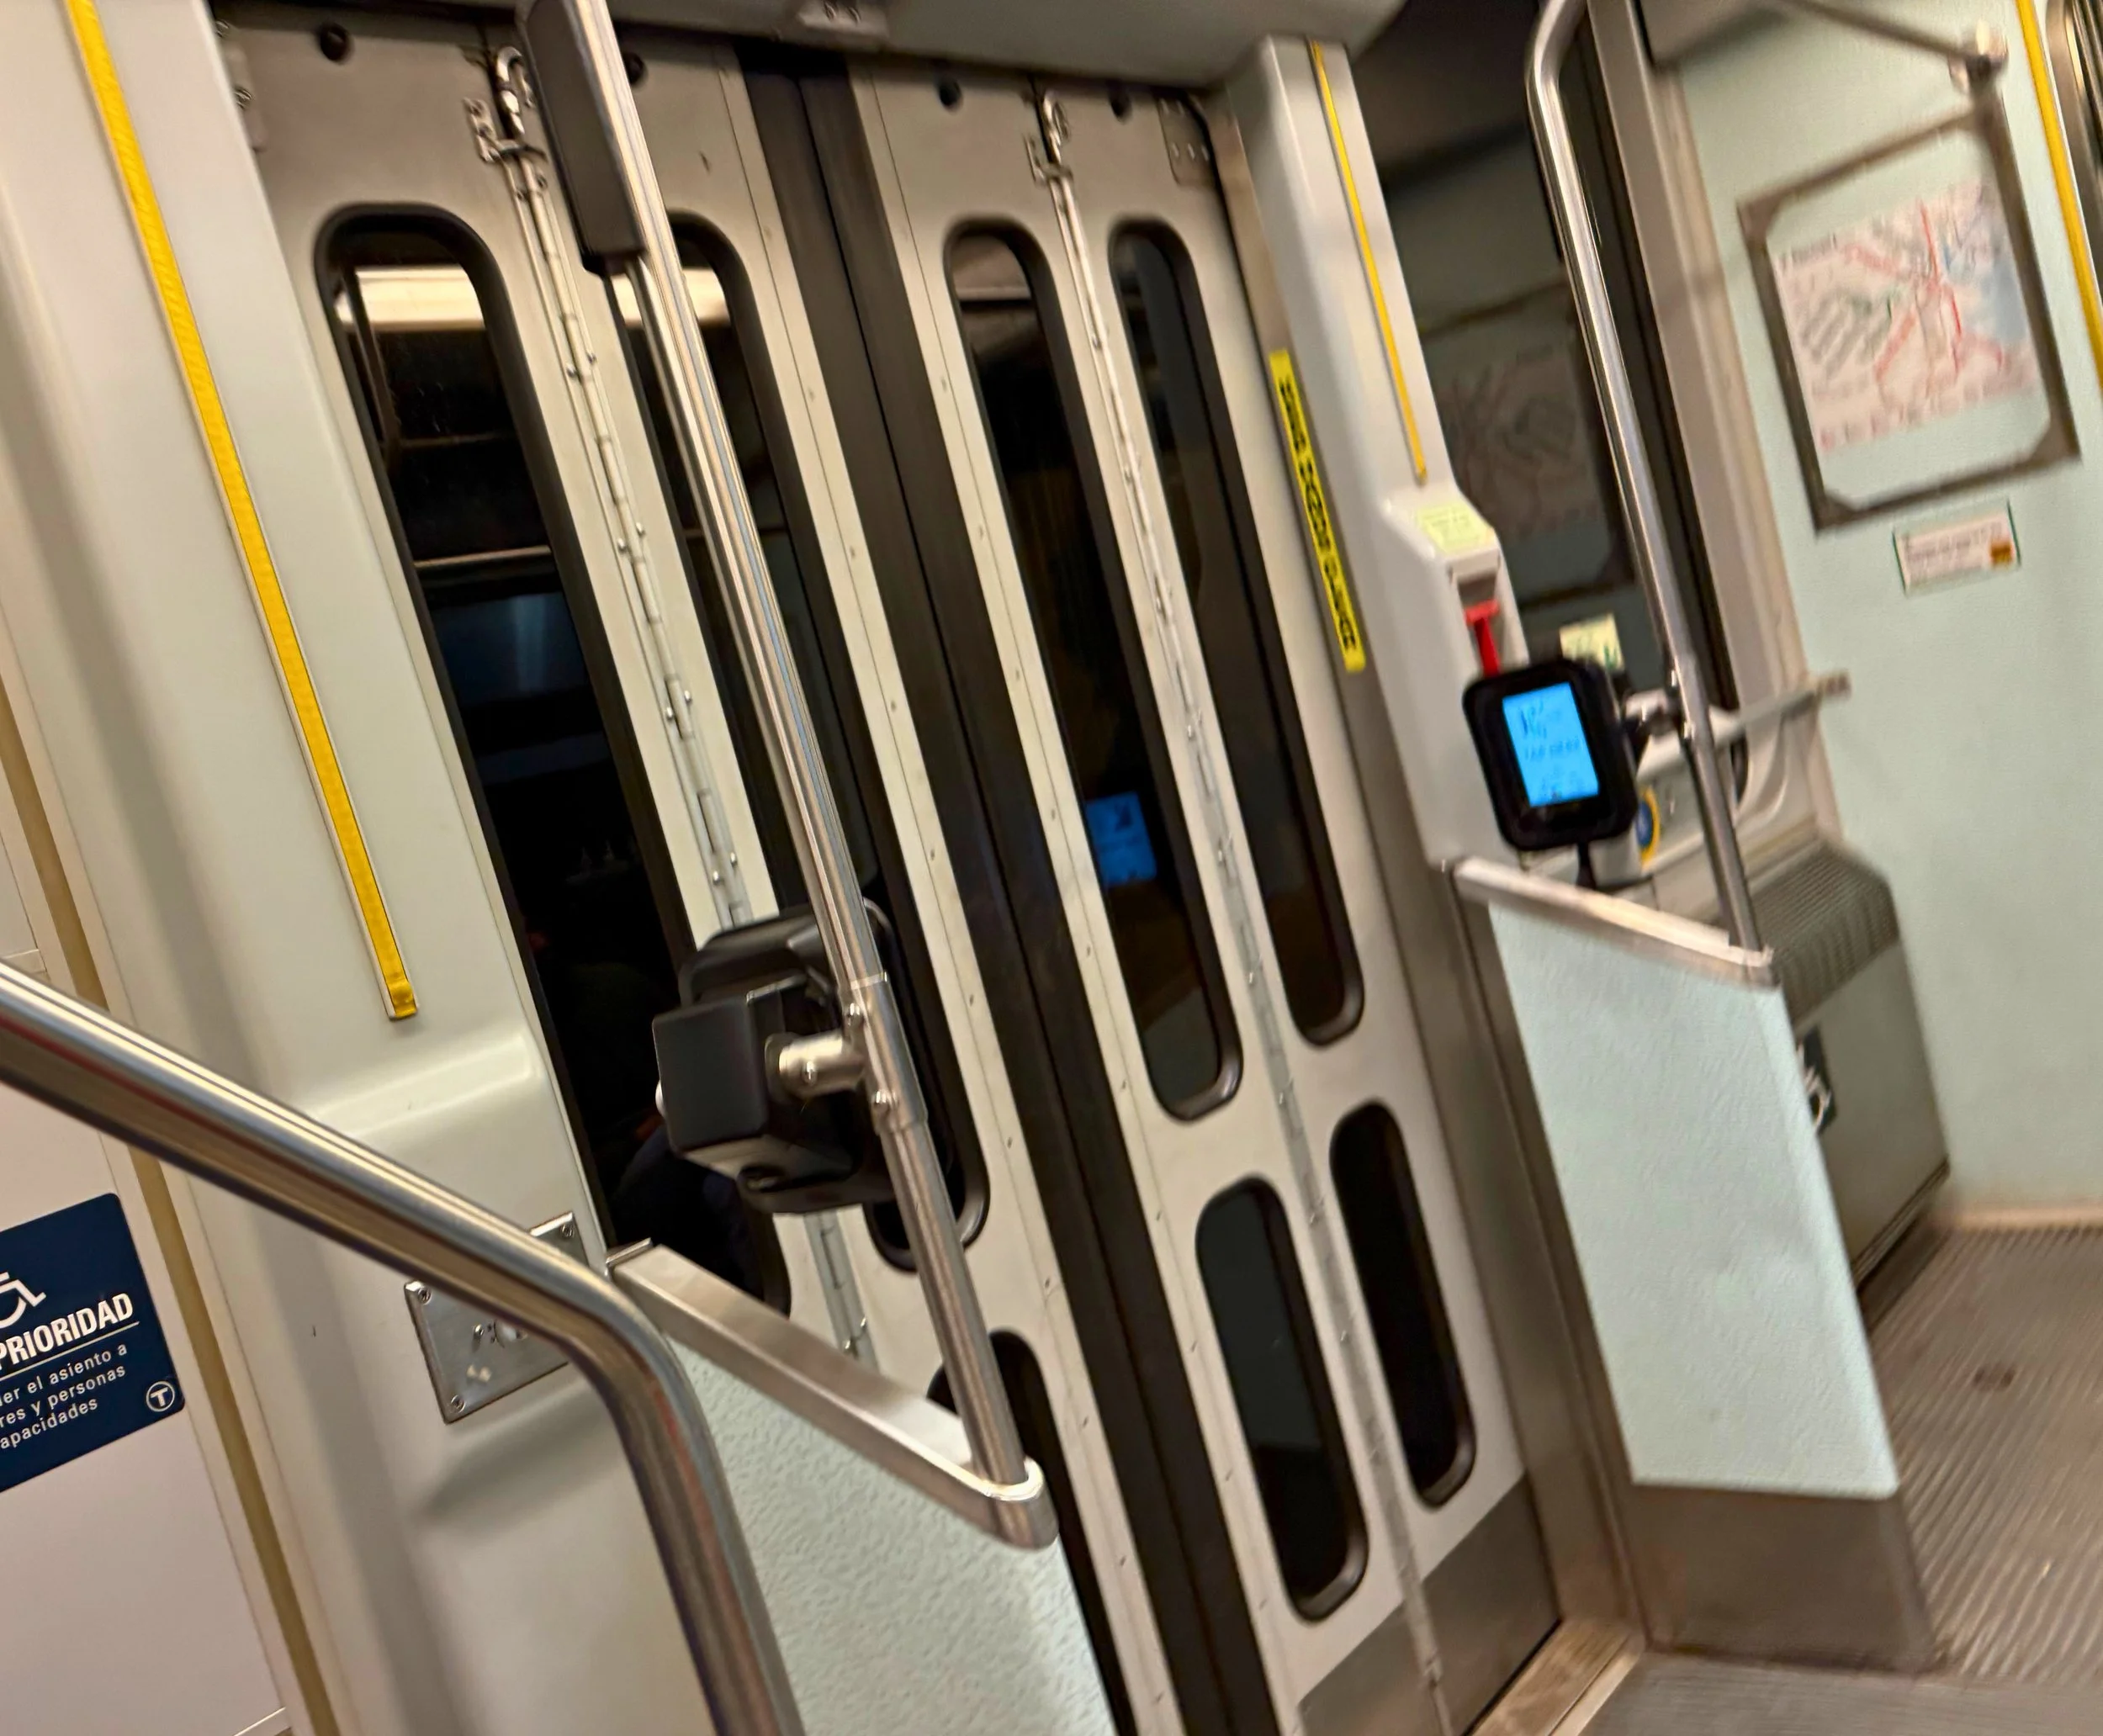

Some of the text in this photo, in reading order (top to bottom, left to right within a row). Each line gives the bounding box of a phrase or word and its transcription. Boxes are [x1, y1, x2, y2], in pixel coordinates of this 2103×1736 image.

[0, 1343, 128, 1407] er el asiento a
[31, 1400, 40, 1416] y
[47, 1365, 126, 1410] personas
[0, 1397, 98, 1448] apacidades
